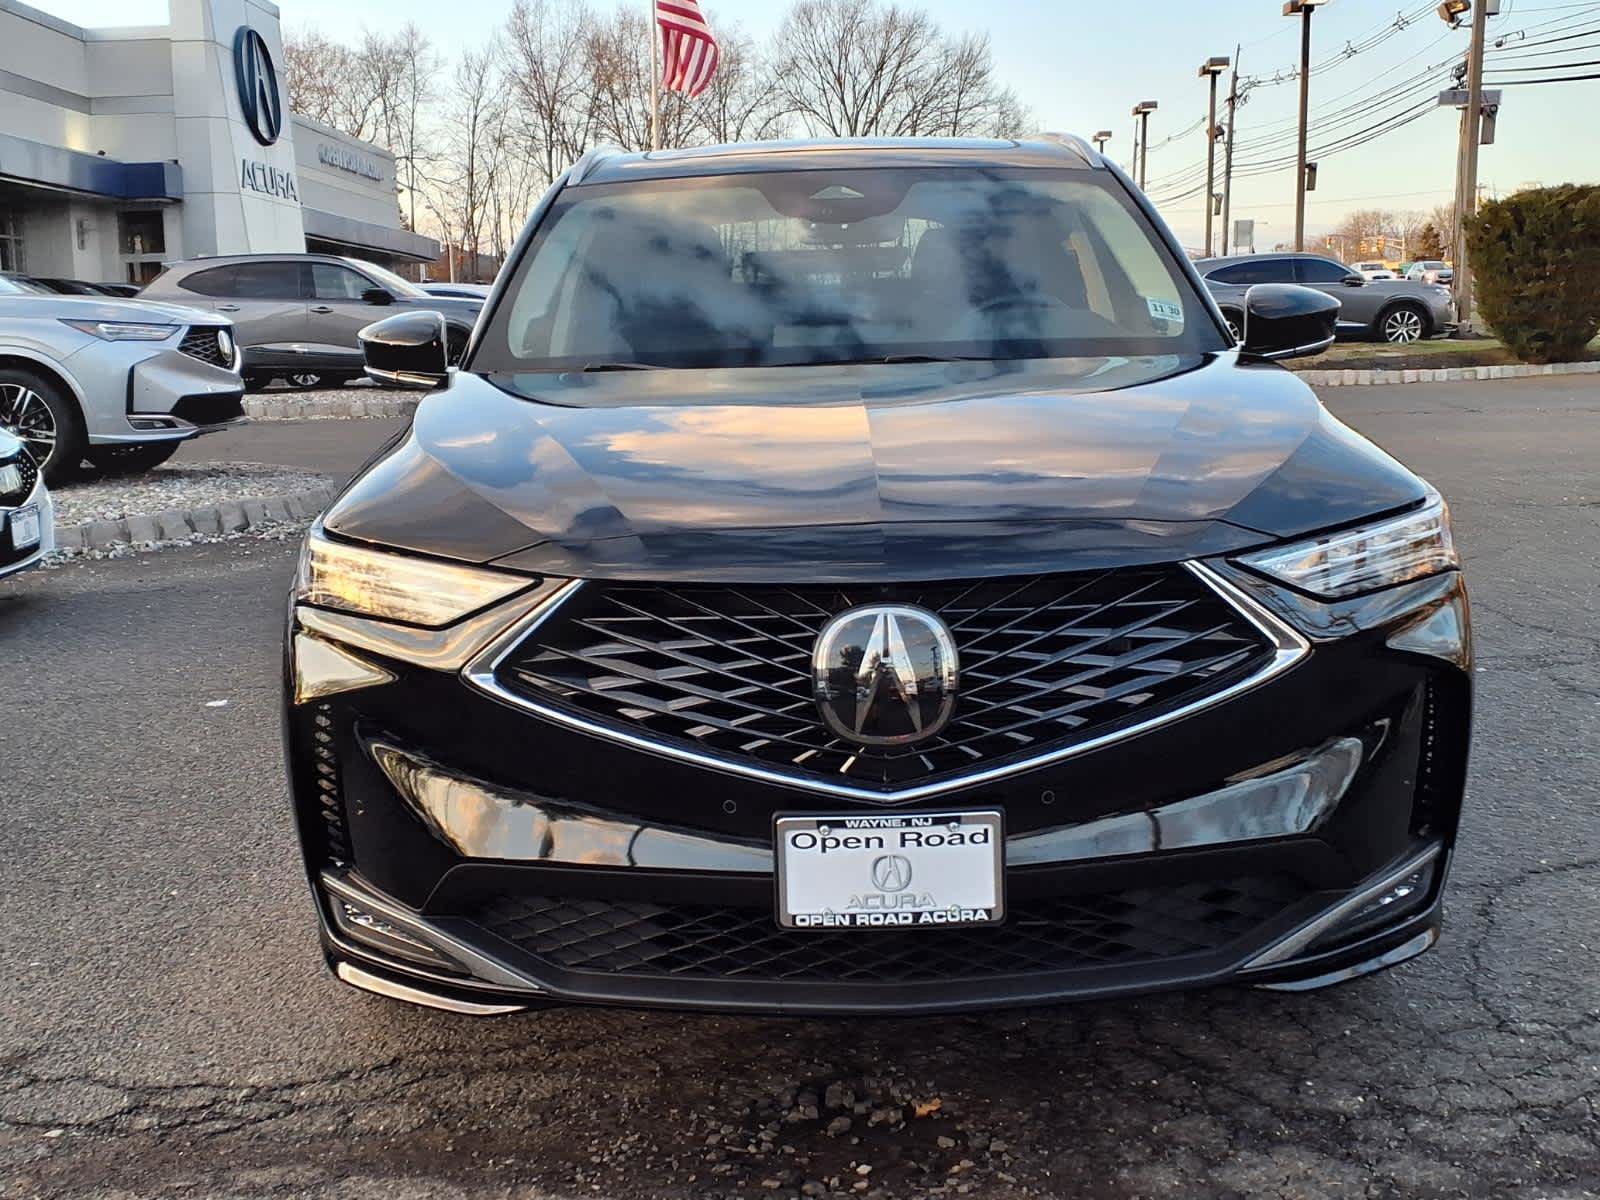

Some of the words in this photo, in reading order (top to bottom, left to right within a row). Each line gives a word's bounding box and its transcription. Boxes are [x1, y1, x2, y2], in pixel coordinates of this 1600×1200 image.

[241, 159, 298, 202] ACURA
[911, 817, 933, 827] NJ
[790, 832, 884, 854] Open
[899, 828, 989, 848] Road
[845, 893, 937, 910] ACURA
[795, 912, 850, 927] OPEN
[855, 911, 913, 925] ROAD
[918, 908, 989, 923] ACURA
